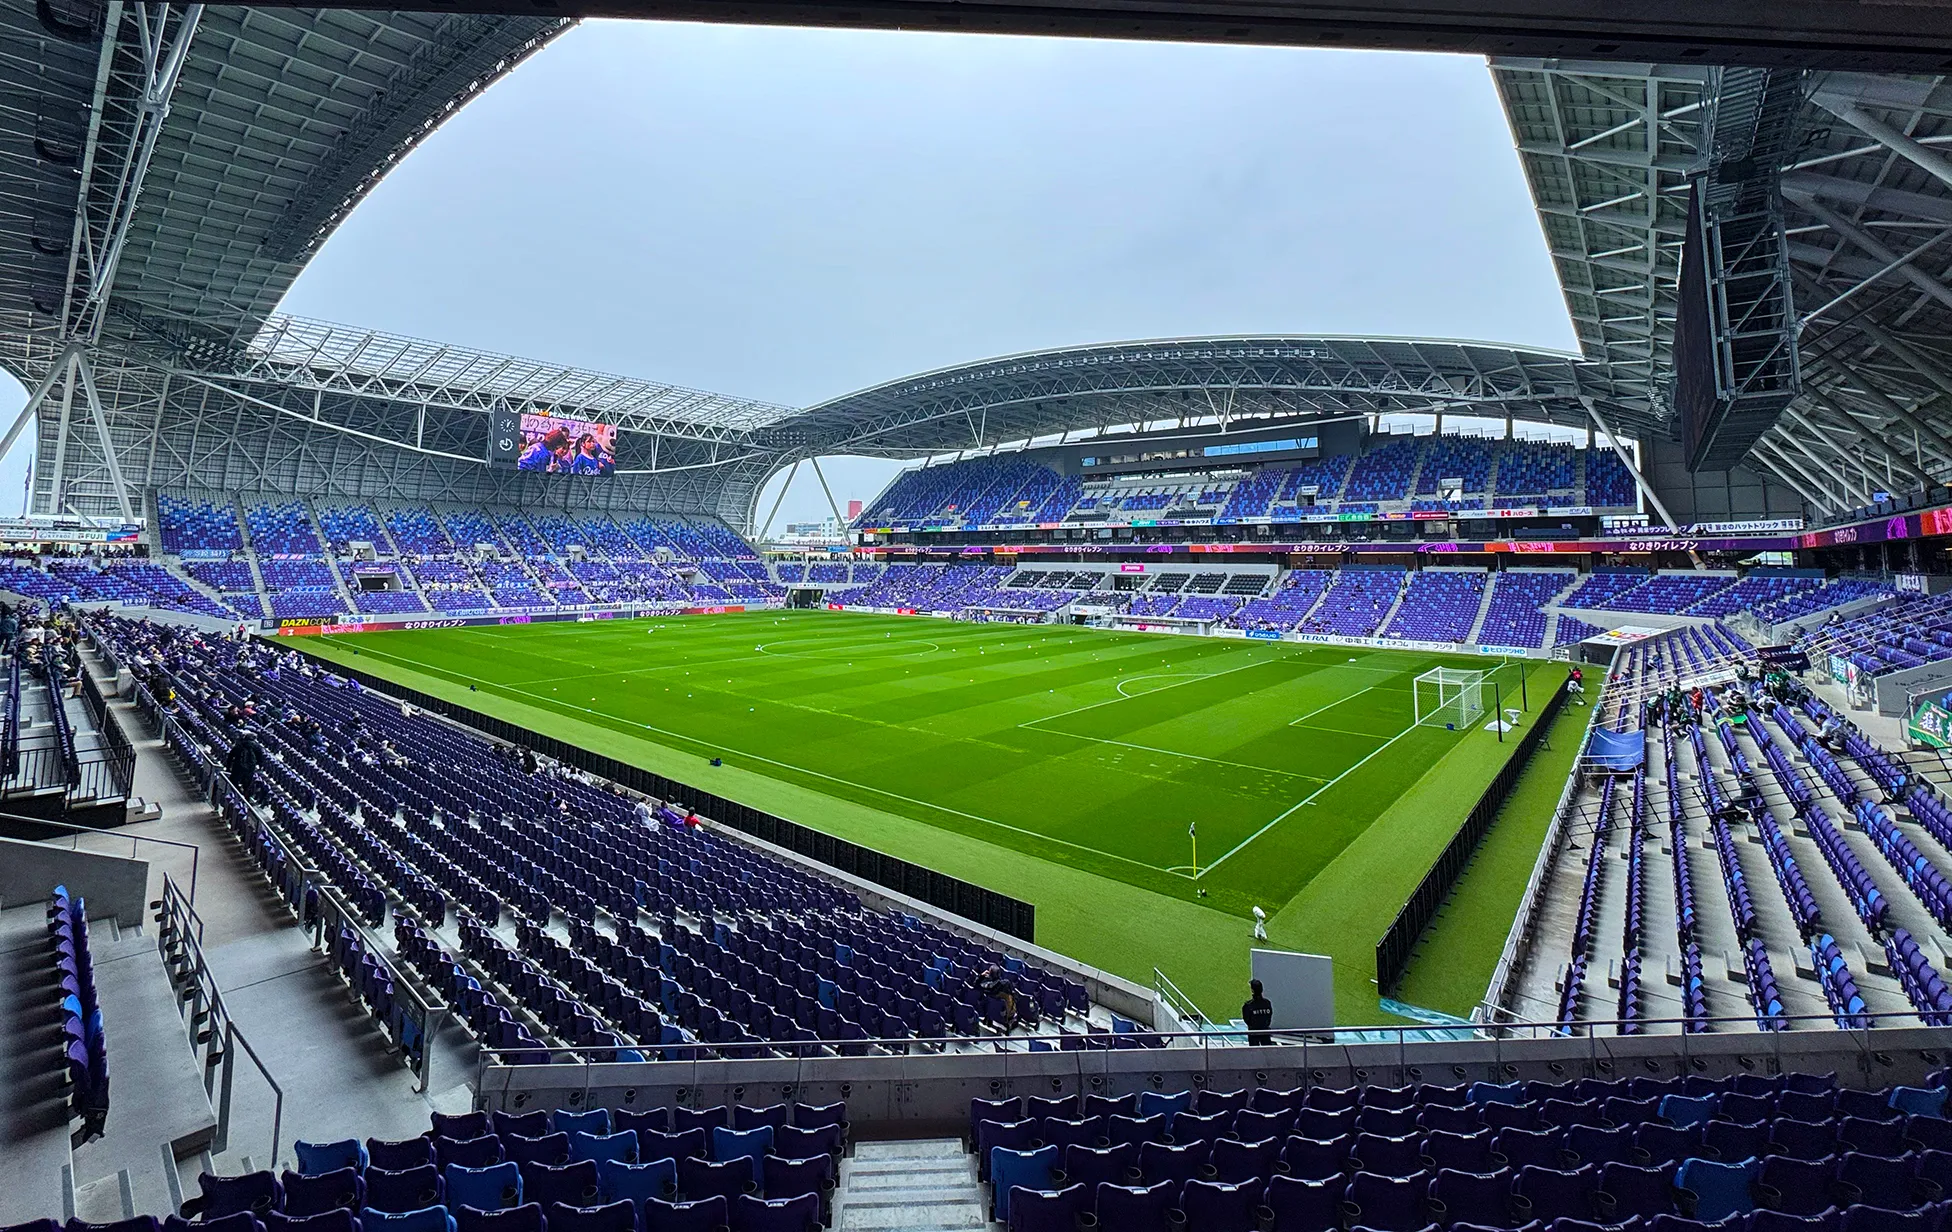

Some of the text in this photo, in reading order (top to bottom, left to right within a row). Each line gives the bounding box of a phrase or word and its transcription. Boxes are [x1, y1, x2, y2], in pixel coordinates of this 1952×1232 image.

[1064, 545, 1103, 553] なりきりイレブン
[1293, 544, 1351, 552] なりきりイレブン
[1629, 540, 1699, 551] なりきりイレブン
[640, 609, 681, 617] なりきりイレブン
[404, 619, 467, 630] なりきりイレブン
[1301, 634, 1329, 642] TERAL
